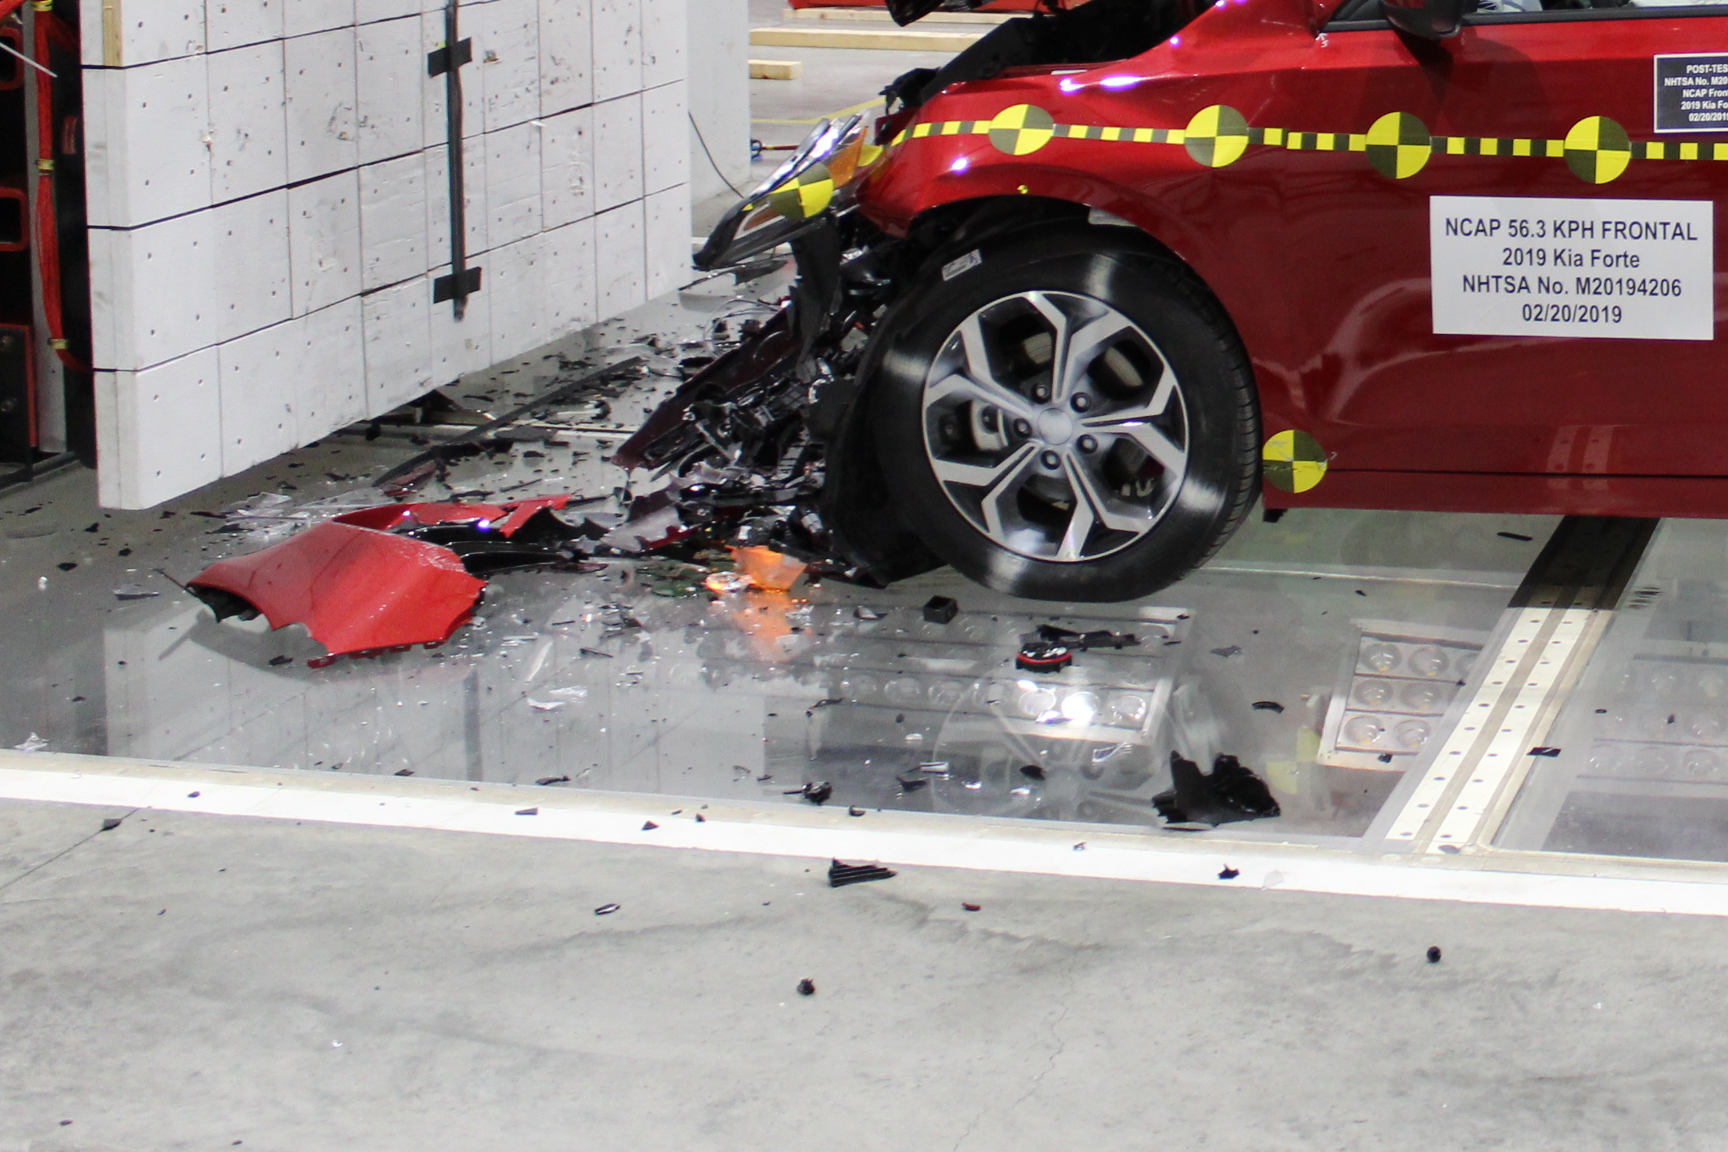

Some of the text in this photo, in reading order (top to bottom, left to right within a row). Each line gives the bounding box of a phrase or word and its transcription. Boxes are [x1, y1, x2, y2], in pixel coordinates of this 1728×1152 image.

[1664, 77, 1694, 86] NHTSA
[1695, 76, 1710, 86] No.
[1682, 89, 1707, 98] NCAP
[1680, 101, 1701, 110] 2019
[1702, 100, 1716, 109] Kia
[1445, 217, 1698, 241] NCAP 56.3 KPH FRONTAL
[1502, 248, 1640, 268] 2019 Kia Forte
[1462, 274, 1682, 297] NHTSA No. M20194206
[1522, 303, 1622, 324] 02/20/2019
